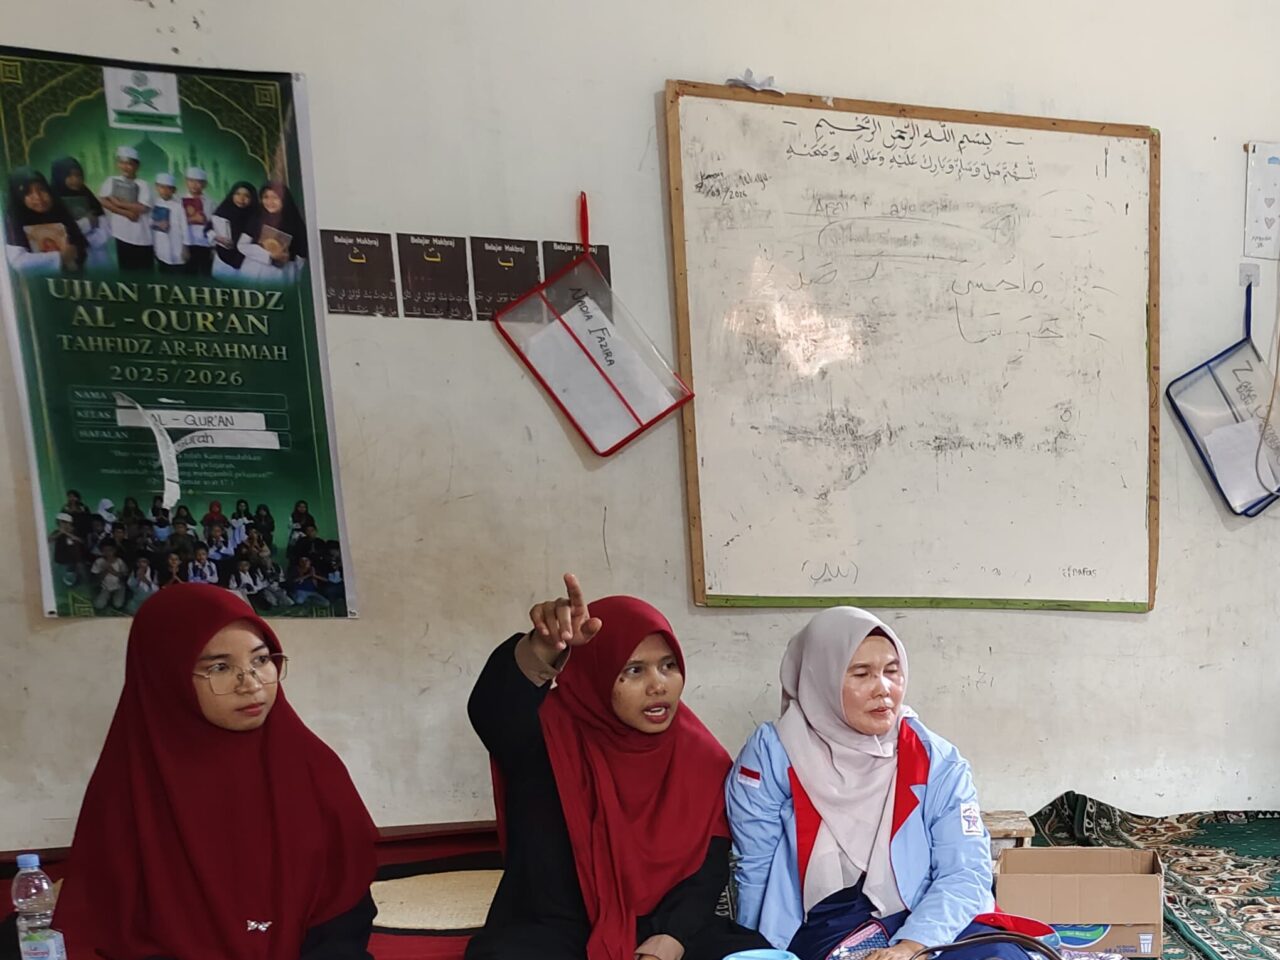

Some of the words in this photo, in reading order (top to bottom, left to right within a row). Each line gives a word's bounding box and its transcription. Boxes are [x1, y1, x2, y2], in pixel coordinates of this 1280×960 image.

[46, 278, 138, 302] UJIAN
[148, 284, 284, 311] TAHFIDZ
[71, 305, 115, 327] AL
[57, 334, 153, 354] TAHFIDZ
[159, 340, 288, 361] AR-RAHMAH
